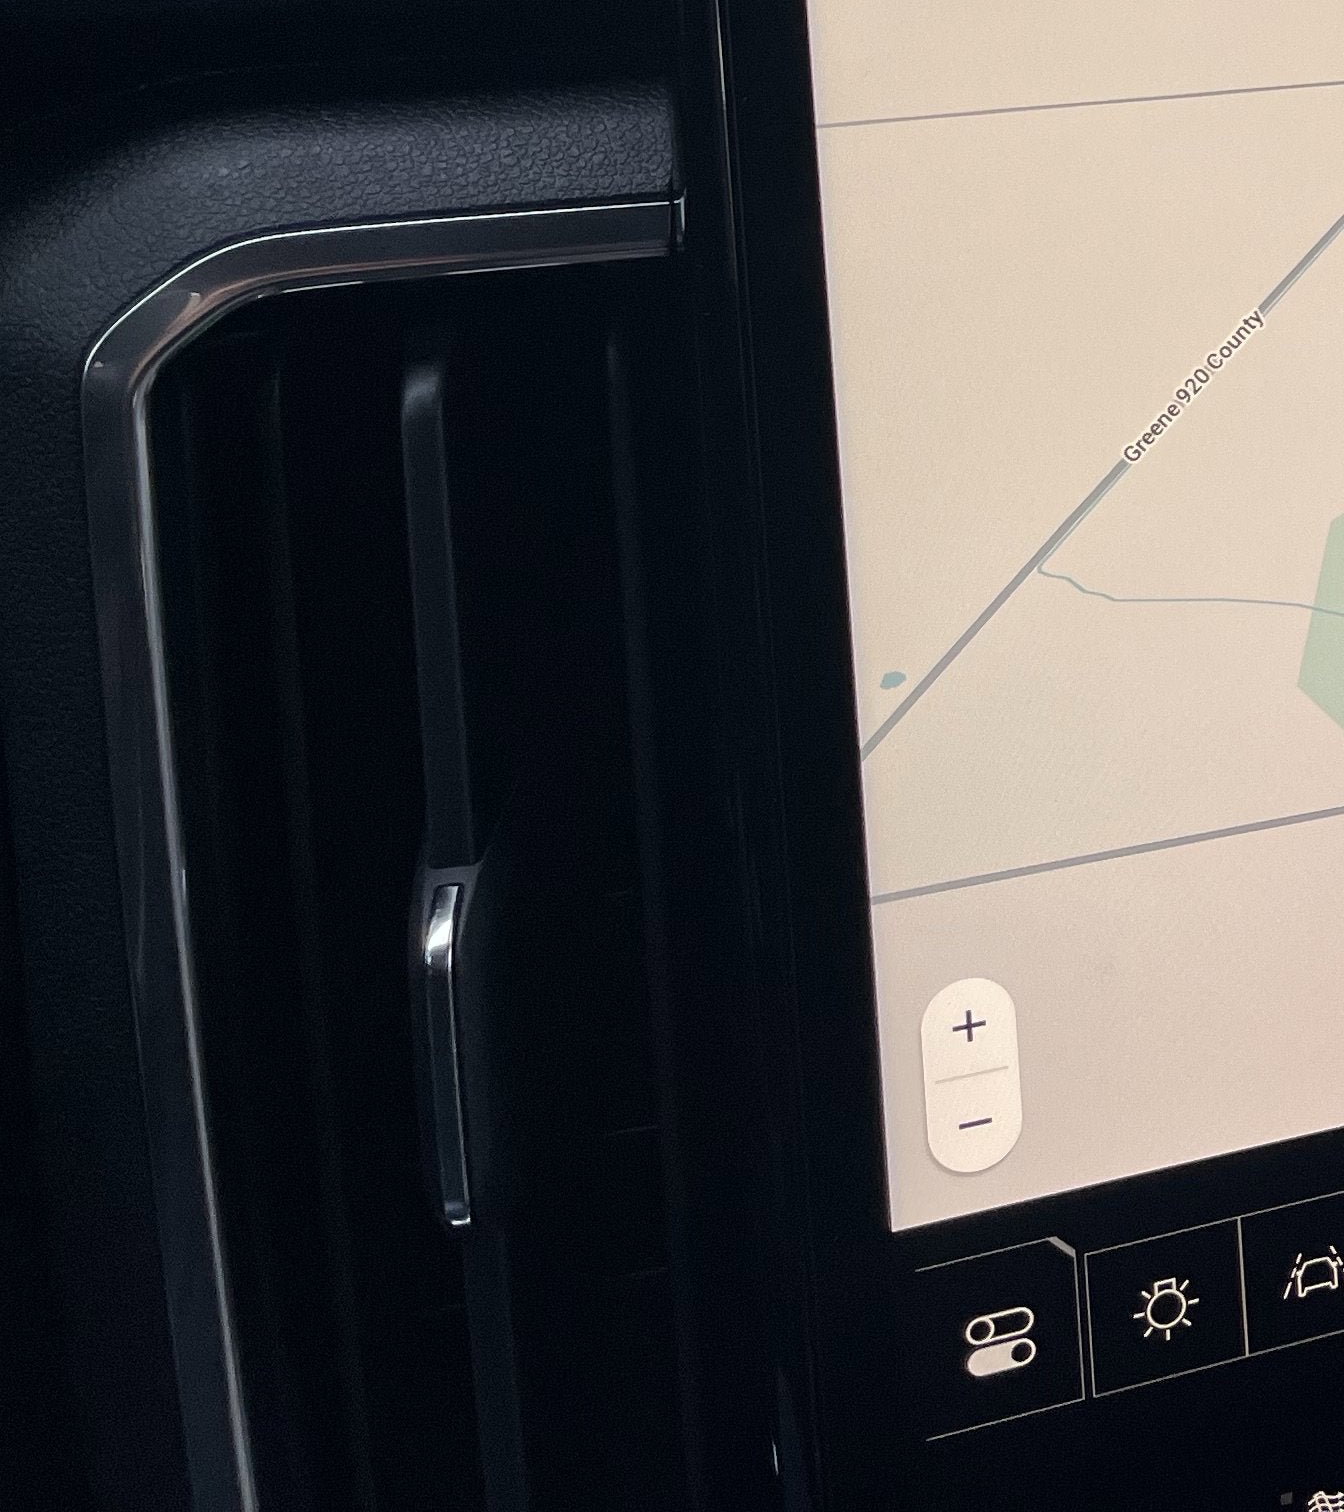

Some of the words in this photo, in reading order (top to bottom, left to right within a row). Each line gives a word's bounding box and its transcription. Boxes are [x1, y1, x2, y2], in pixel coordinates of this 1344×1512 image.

[1123, 403, 1181, 462] Greene
[1175, 368, 1211, 404] 920
[1206, 310, 1265, 370] County
